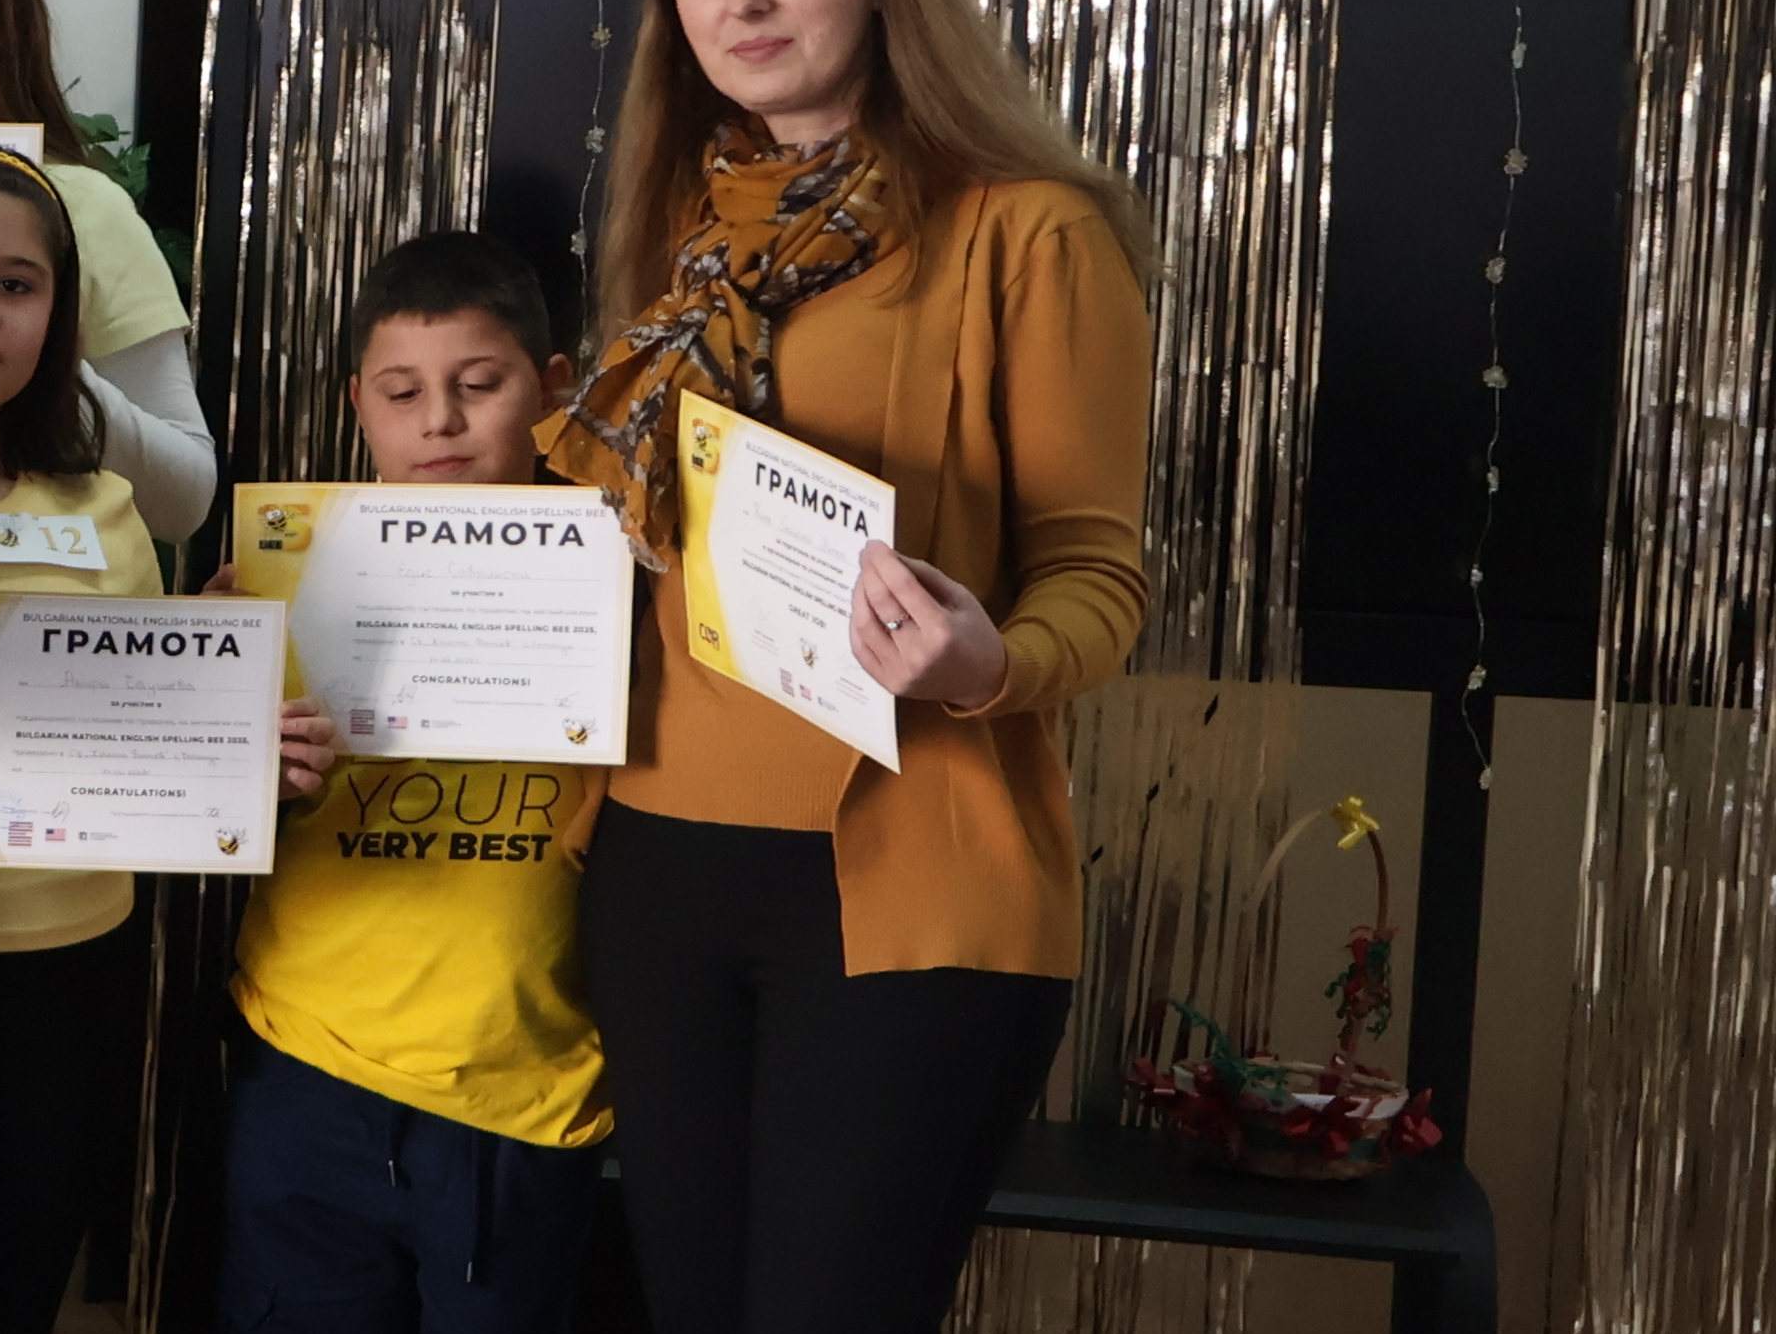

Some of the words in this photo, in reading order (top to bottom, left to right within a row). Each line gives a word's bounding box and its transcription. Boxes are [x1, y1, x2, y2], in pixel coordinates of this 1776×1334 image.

[359, 504, 422, 515] BULGARIAN
[425, 505, 479, 516] NATIONAL
[482, 505, 528, 517] ENGLISH
[532, 506, 584, 518] SPELLING
[587, 507, 607, 518] BEE
[756, 462, 869, 537] ГРАМОТА
[38, 527, 88, 555] 12
[380, 520, 584, 548] ГРАМОТА
[22, 613, 83, 625] BULGARIAN
[86, 614, 139, 626] NATIONAL
[142, 615, 186, 627] ENGLISH
[190, 616, 240, 628] SPELLING
[242, 617, 262, 629] BEE
[41, 628, 241, 659] ГРАМОТА
[411, 675, 531, 687] CONGRATULATIONS!
[70, 787, 186, 799] CONGRATULATIONS!
[347, 773, 562, 828] YOUR
[337, 832, 438, 859] VERY
[449, 833, 552, 862] BEST
